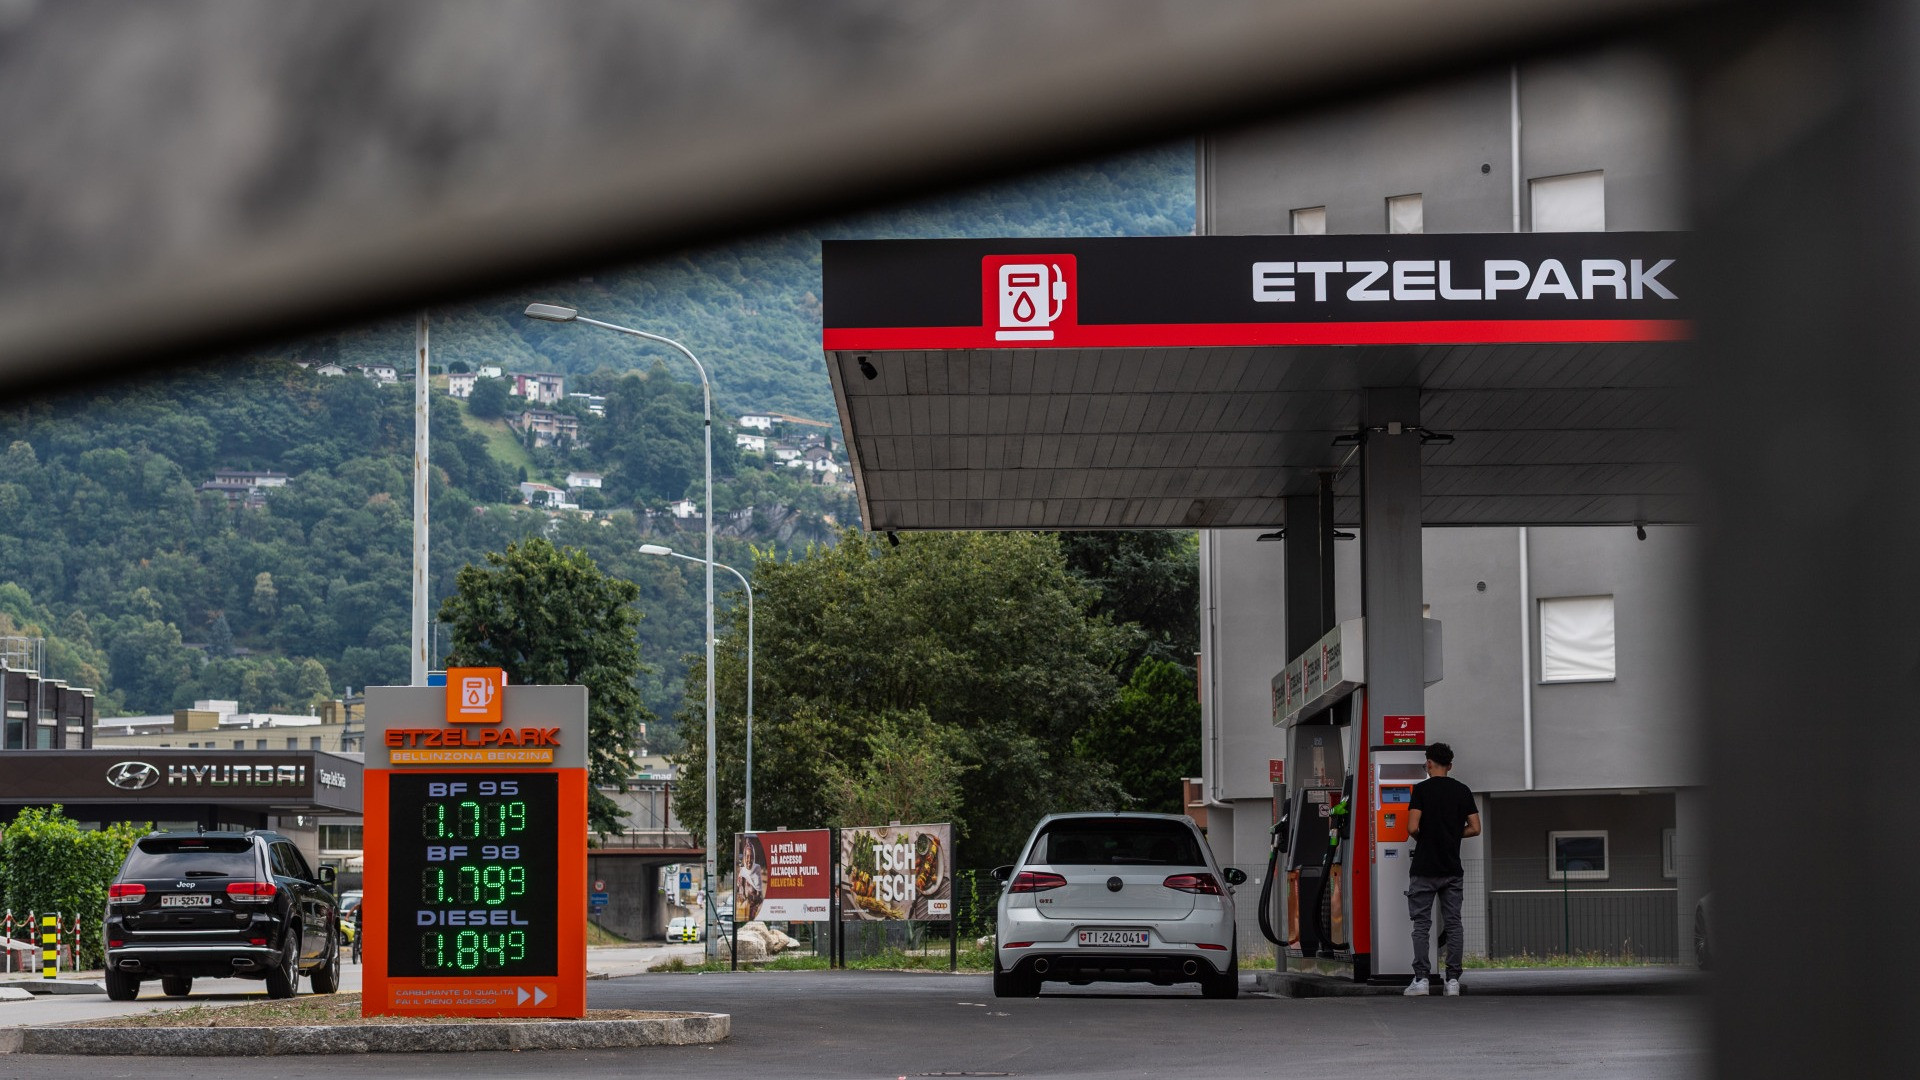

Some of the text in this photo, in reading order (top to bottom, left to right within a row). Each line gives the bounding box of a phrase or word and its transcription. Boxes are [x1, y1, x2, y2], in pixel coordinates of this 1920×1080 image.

[1252, 258, 1680, 303] ETZELPARK
[385, 728, 560, 747] ETZELPARK
[392, 751, 550, 761] BELLINZONA BENZINA
[168, 765, 305, 786] HYUNDAI
[428, 781, 519, 797] BF 95
[427, 845, 520, 862] BF 98
[770, 841, 807, 853] LA PIETÀ NON
[770, 853, 802, 865] DÀ ACCESSO
[872, 843, 916, 871] TSCH
[799, 865, 820, 876] PULITA.
[176, 881, 196, 889] Jeep
[770, 878, 796, 888] HELVETAS
[872, 874, 916, 902] TSCH
[417, 910, 529, 926] DIESEL
